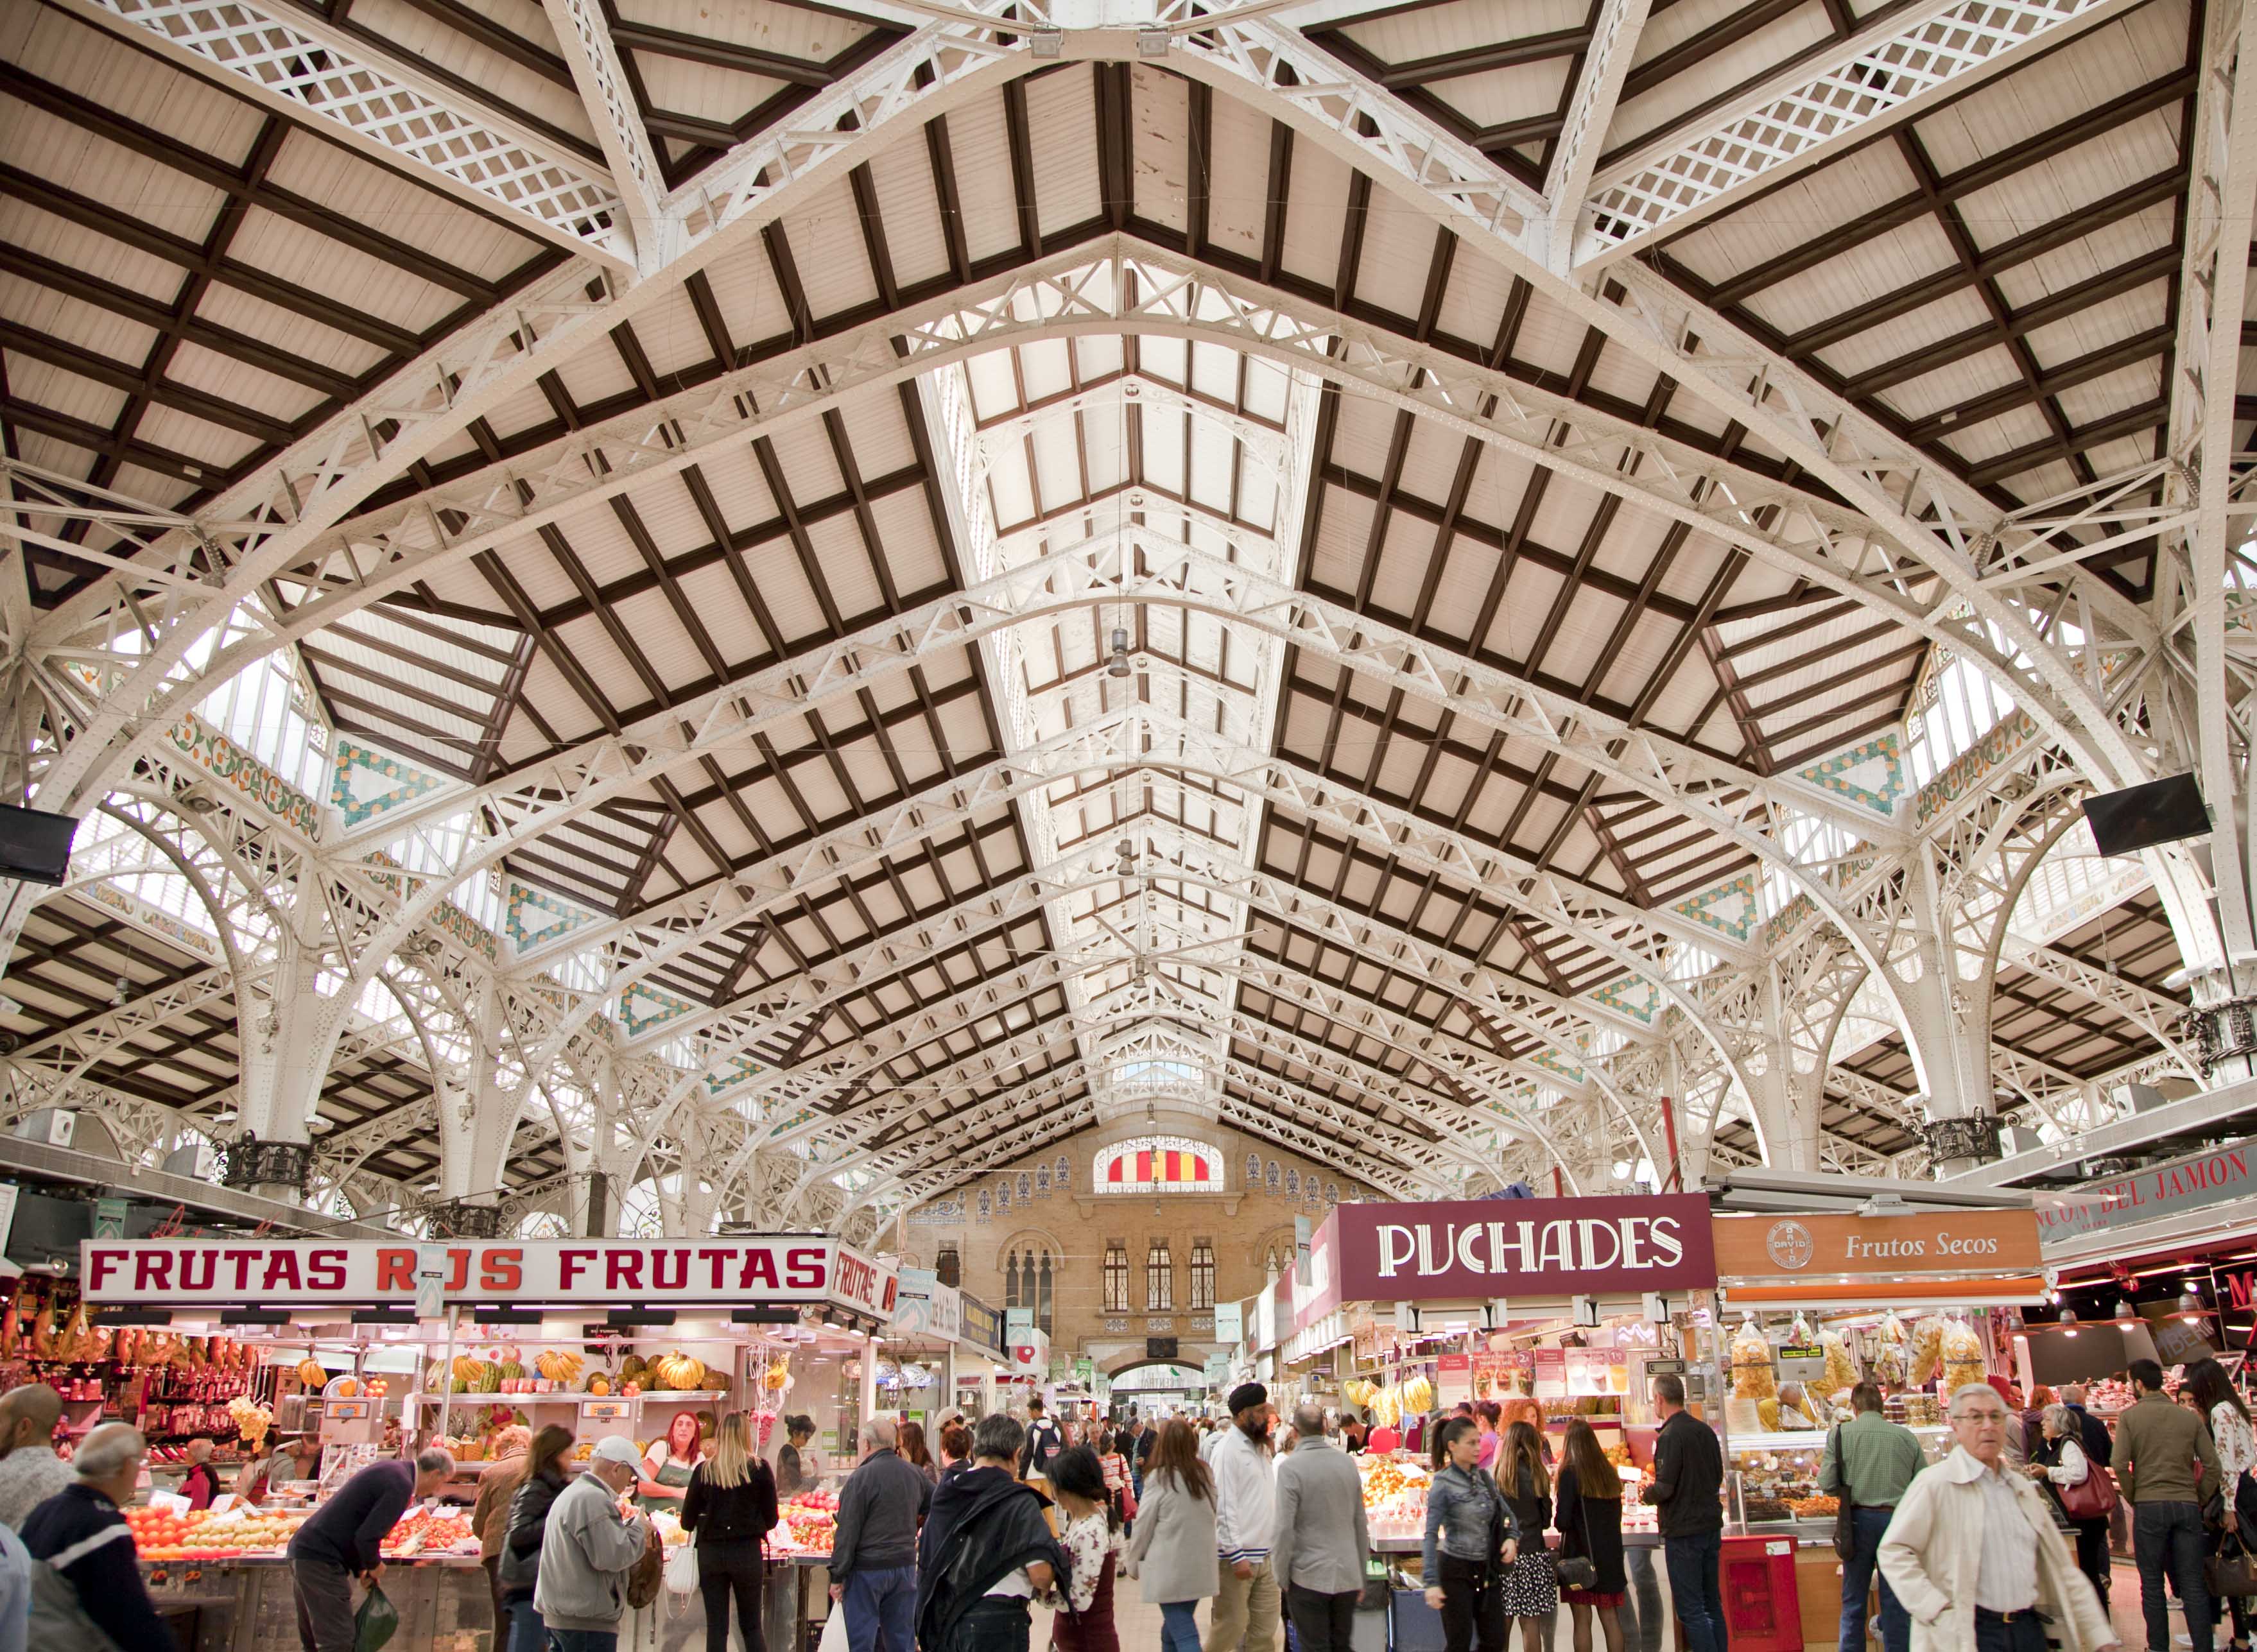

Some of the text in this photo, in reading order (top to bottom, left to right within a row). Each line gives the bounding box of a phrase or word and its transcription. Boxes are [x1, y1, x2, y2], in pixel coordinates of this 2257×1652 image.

[2099, 1180, 2145, 1214] DEL
[2155, 1150, 2247, 1201] JAMON
[89, 1250, 348, 1290] FRUTAS
[558, 1248, 826, 1289] FRUTAS
[1376, 1217, 1682, 1277] PUCHADES
[1845, 1232, 1997, 1259] Frutos Secos
[833, 1250, 878, 1305] FRUTAS
